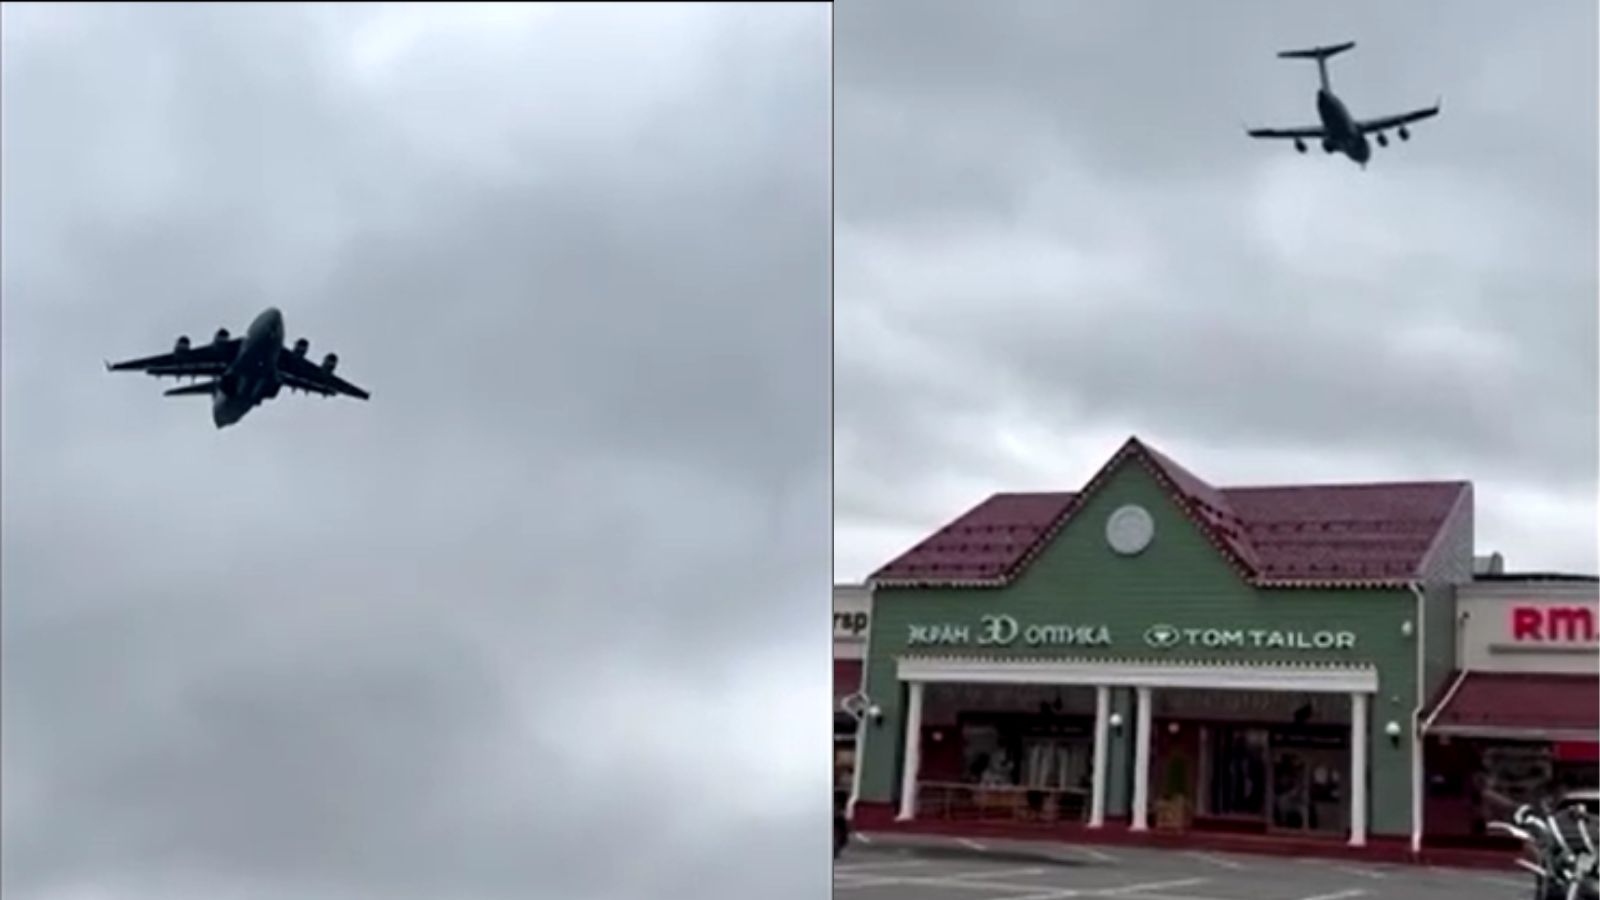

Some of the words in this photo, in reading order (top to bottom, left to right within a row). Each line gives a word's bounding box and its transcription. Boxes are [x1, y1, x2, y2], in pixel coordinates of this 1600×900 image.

[1024, 624, 1111, 645] ОПТИКА
[1183, 629, 1243, 647] TOM
[1248, 630, 1356, 649] TAILOR
